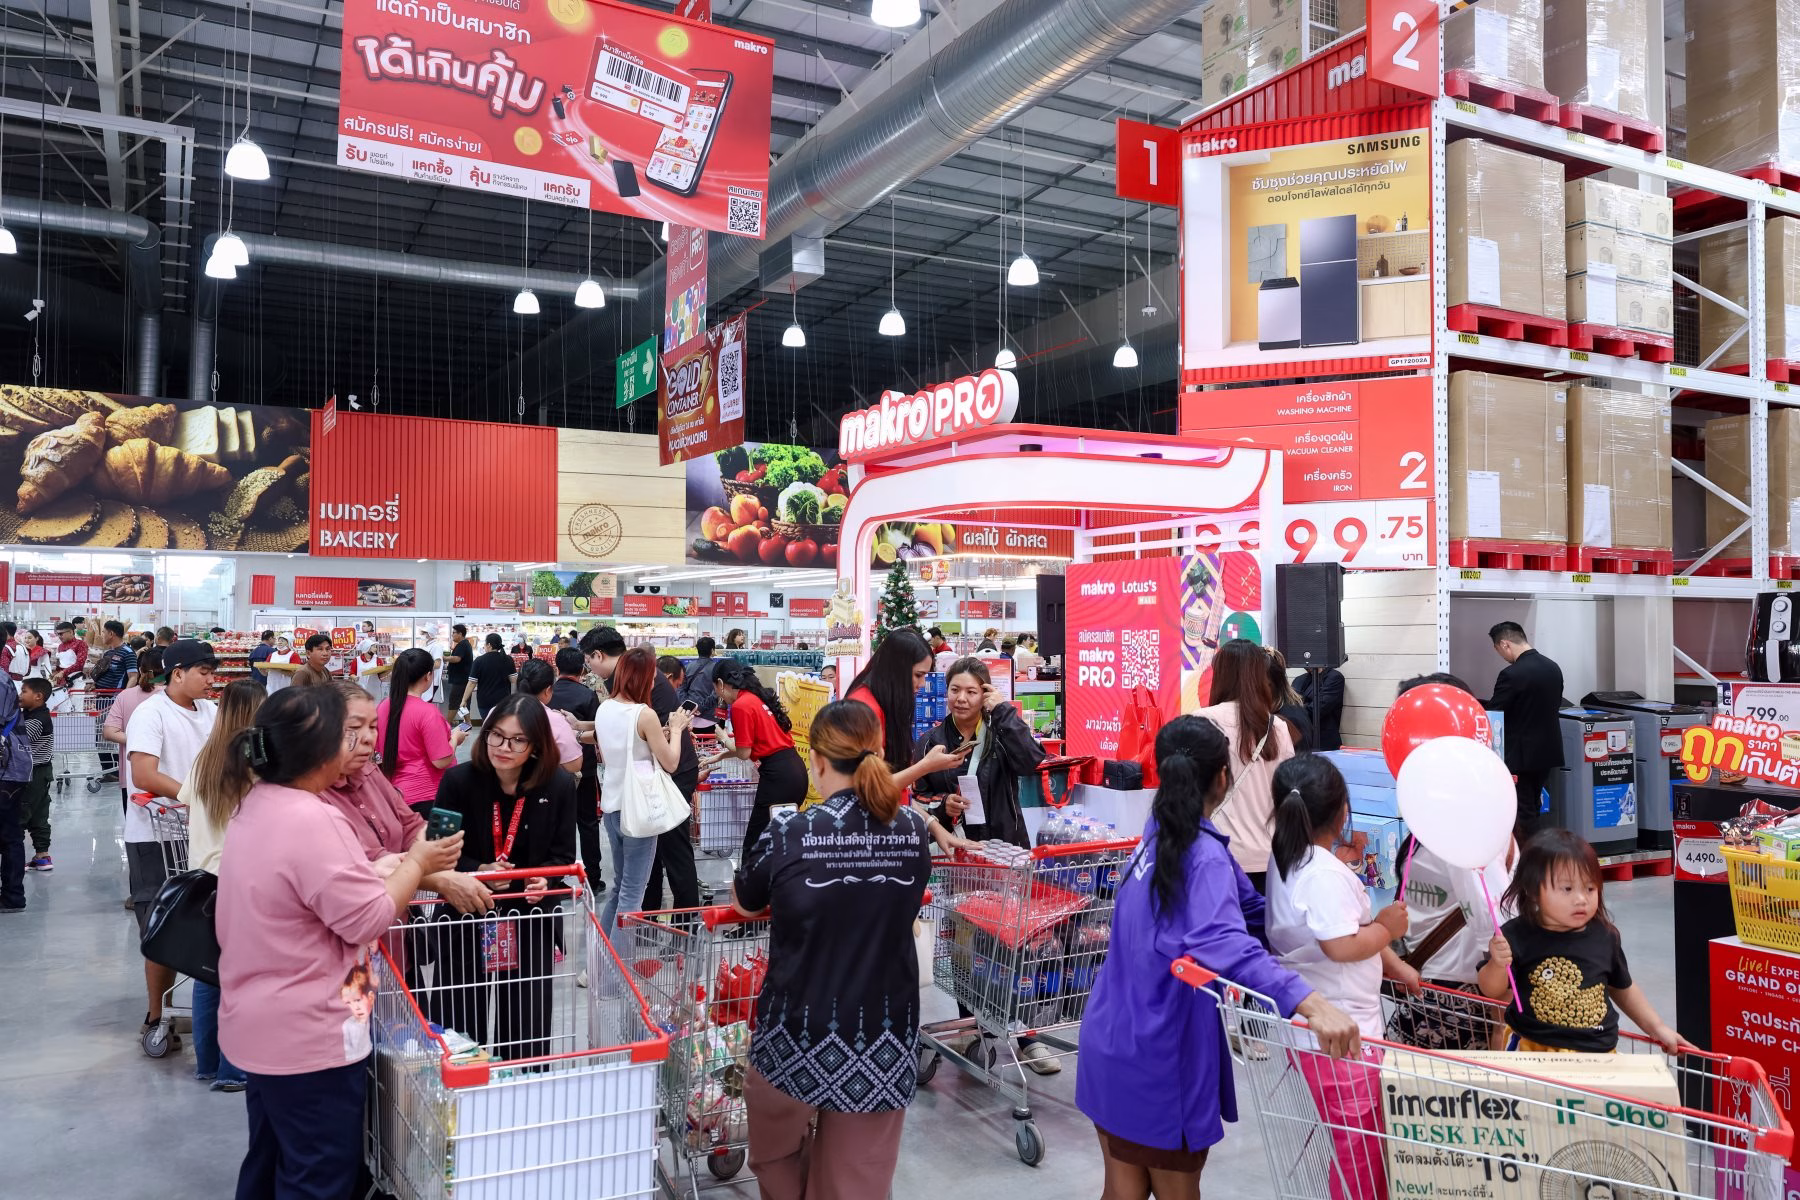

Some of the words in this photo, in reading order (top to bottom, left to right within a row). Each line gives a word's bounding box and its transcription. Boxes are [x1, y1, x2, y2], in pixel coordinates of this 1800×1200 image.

[376, 0, 531, 44] แตถาเป็นสมาชิก
[734, 39, 768, 54] makro
[1392, 12, 1420, 71] 2
[357, 36, 545, 112] ได้เกินคุ้ม
[345, 143, 368, 162] รับ
[1187, 137, 1238, 154] makro
[1347, 135, 1422, 155] SAMSUNG
[1143, 140, 1158, 186] 1
[839, 395, 931, 455] makro
[934, 373, 1002, 434] PRO
[1277, 408, 1315, 416] WASHING
[1316, 405, 1353, 414] MACHINE
[1286, 447, 1319, 456] VACUUM
[1320, 445, 1353, 454] CLEANER
[1400, 451, 1427, 490] 2
[1333, 484, 1353, 492] IRON
[320, 493, 399, 522] เบเกอรี่
[320, 529, 399, 550] BAKERY
[582, 521, 609, 541] makro
[1080, 579, 1116, 596] makro
[1121, 579, 1157, 594] Lotus's
[1078, 646, 1115, 662] makro
[1078, 665, 1116, 688] PRO
[1746, 706, 1777, 720] 799
[1713, 714, 1780, 740] makro
[1682, 727, 1744, 781] ถูก
[1747, 740, 1778, 752] ราคา
[1686, 853, 1715, 864] 4,490
[1725, 969, 1780, 991] GRAND
[1785, 982, 1800, 996] O
[1726, 1025, 1777, 1047] STAMP
[1386, 1084, 1522, 1121] imarflex
[1392, 1122, 1465, 1144] DESK
[1473, 1126, 1526, 1147] FAN
[1396, 1179, 1434, 1195] New!
